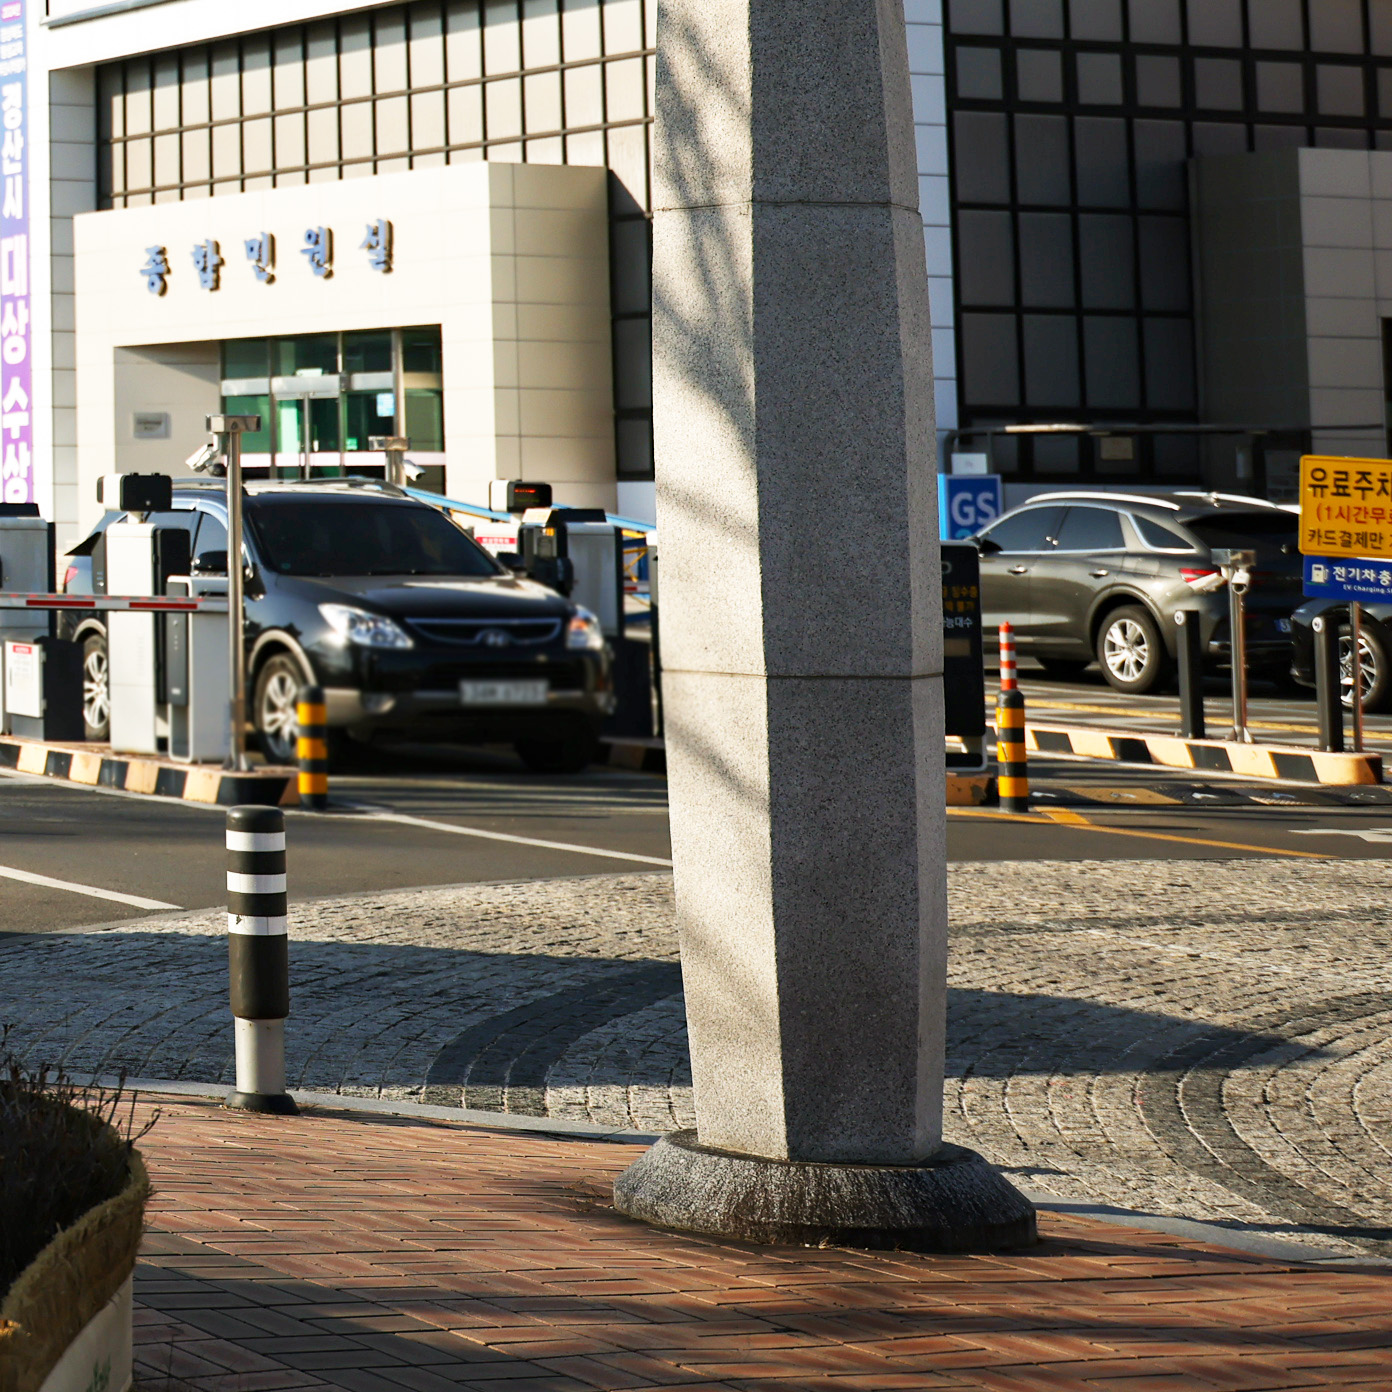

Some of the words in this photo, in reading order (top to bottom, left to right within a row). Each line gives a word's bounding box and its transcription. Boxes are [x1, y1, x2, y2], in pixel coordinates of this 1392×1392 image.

[0, 81, 24, 220] 경산시
[139, 218, 394, 298] 종합민원실
[0, 234, 30, 365] 대상
[1, 376, 32, 504] 수상
[951, 492, 997, 527] GS
[1307, 528, 1384, 551] 카드결제만
[1316, 503, 1392, 525] (1시간무
